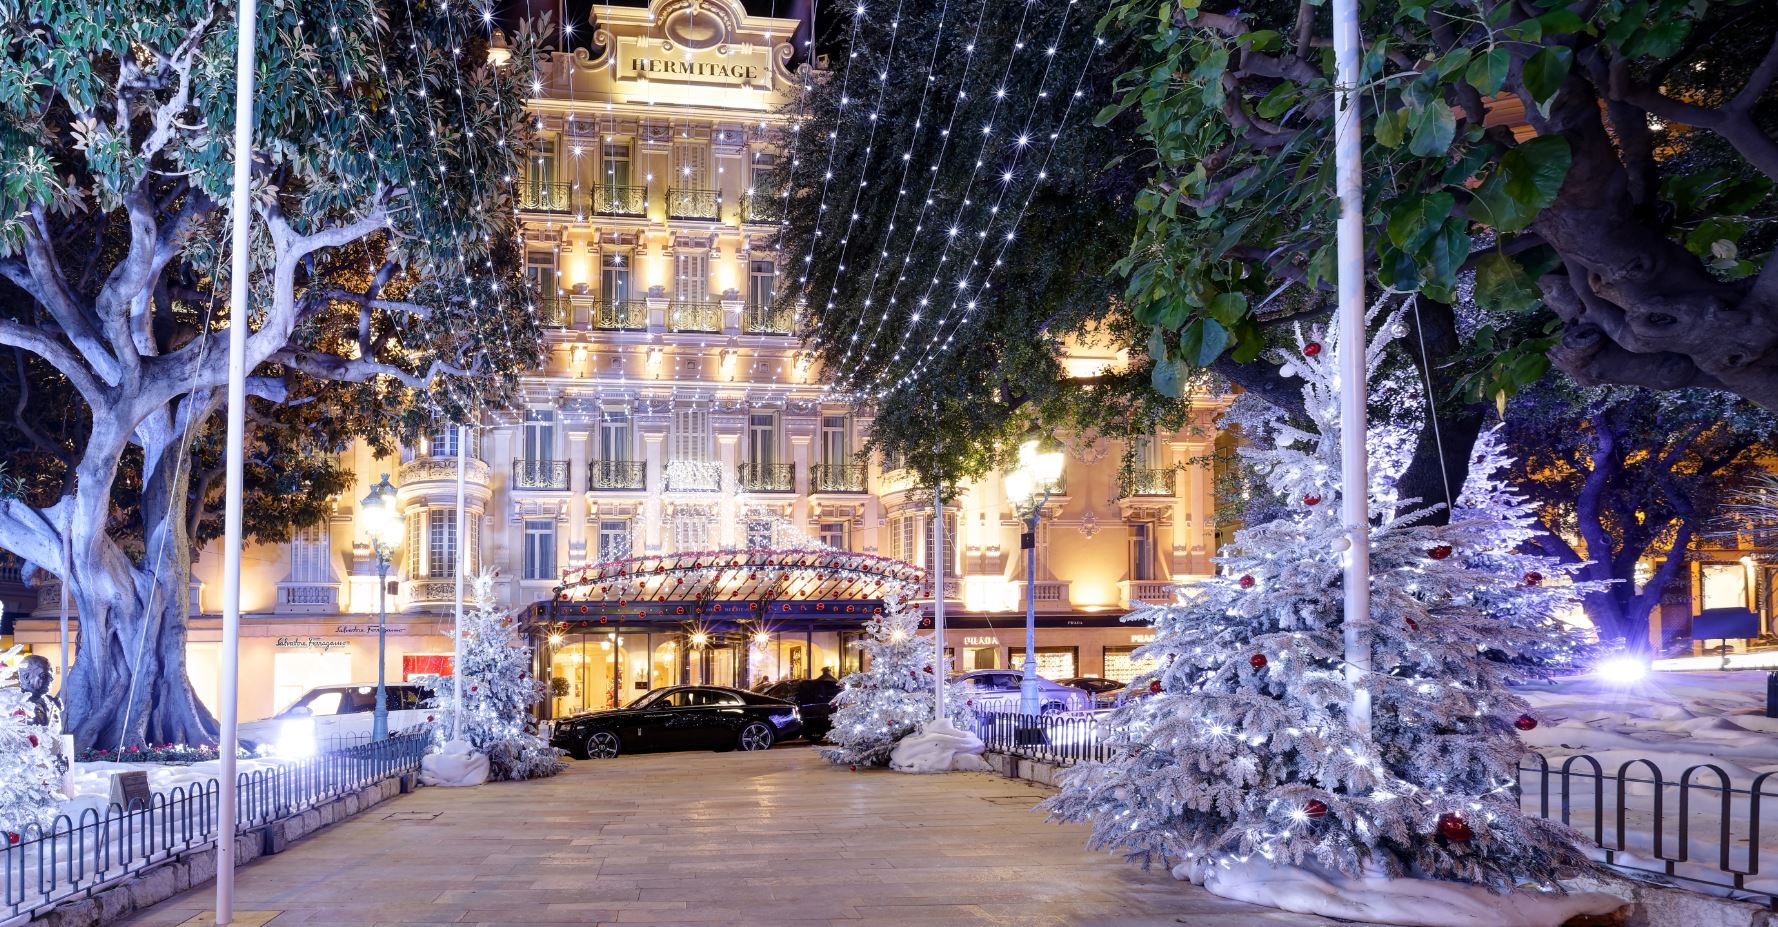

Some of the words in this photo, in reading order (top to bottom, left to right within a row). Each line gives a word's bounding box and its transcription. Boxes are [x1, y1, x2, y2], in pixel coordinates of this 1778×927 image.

[631, 58, 758, 79] HERMITAGE
[275, 637, 307, 648] Salvatore
[308, 637, 349, 652] Ferragamo
[963, 636, 1000, 645] PRADA
